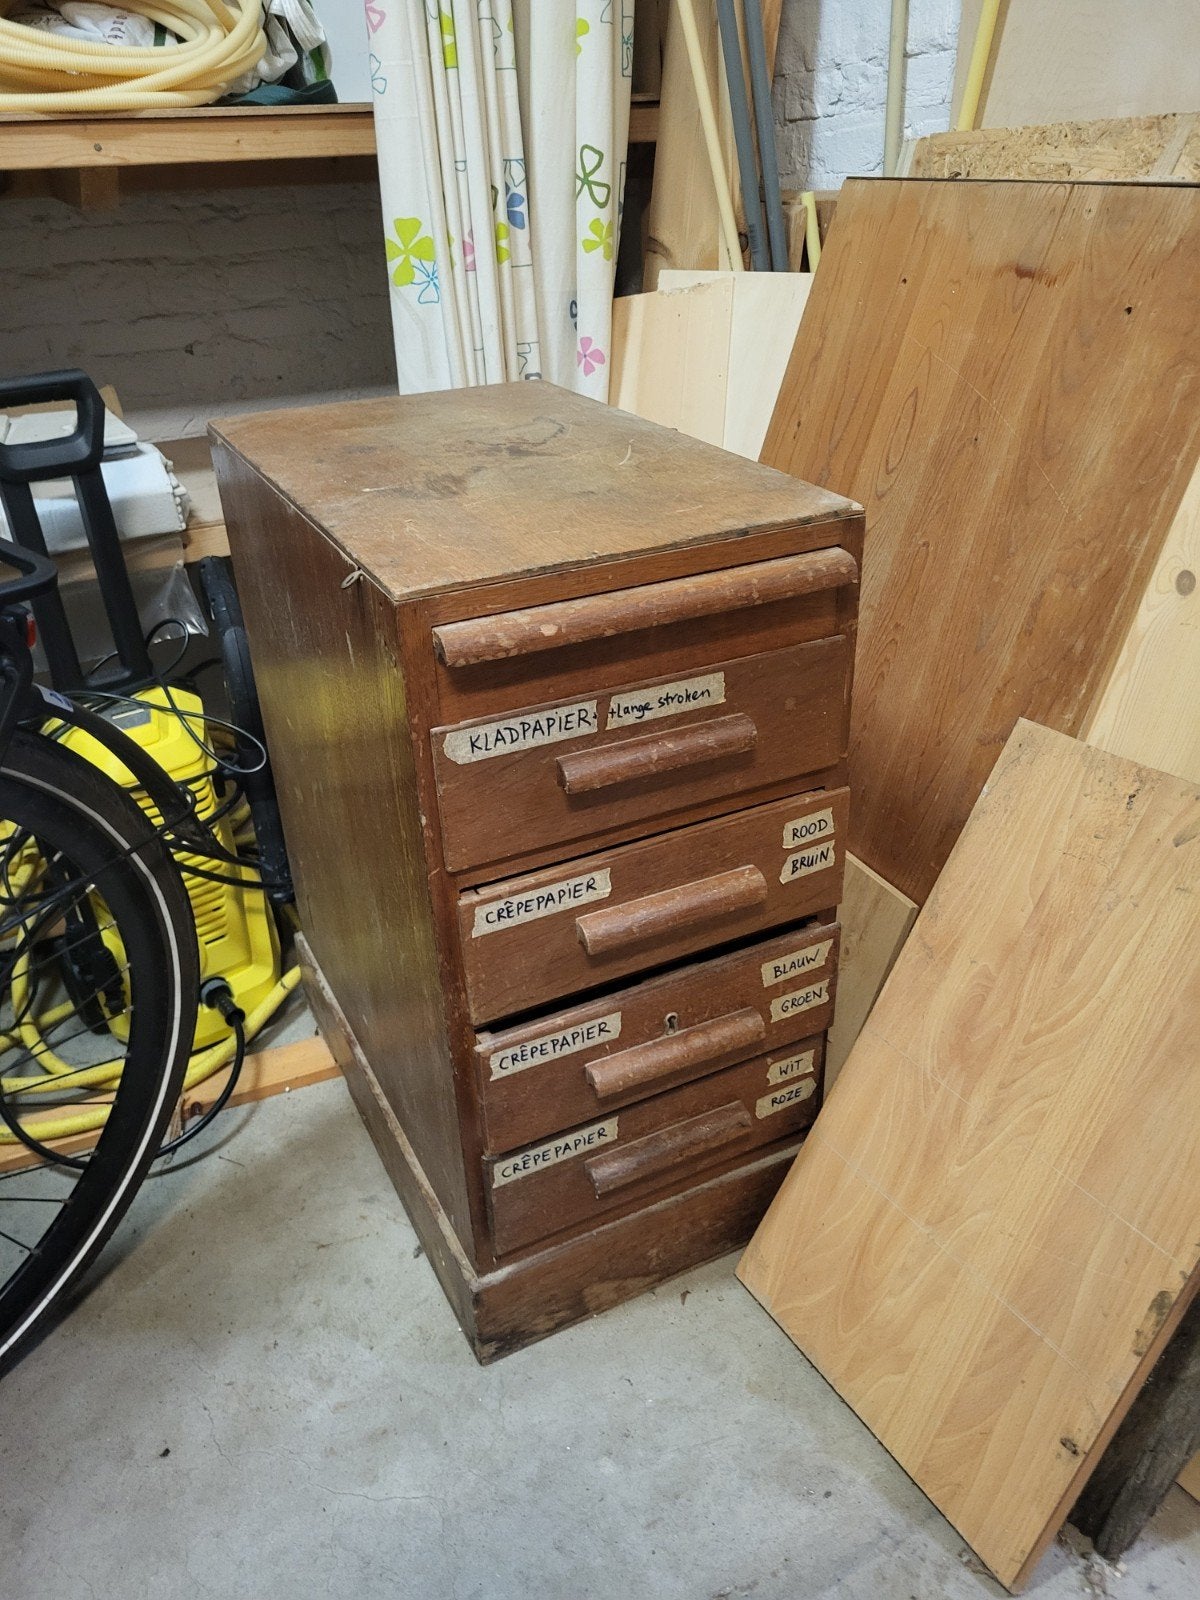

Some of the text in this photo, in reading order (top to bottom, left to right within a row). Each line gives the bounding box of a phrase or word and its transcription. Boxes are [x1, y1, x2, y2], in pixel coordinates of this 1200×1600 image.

[657, 688, 711, 708] stroken
[792, 818, 828, 841] ROOD
[773, 948, 820, 978] BLAUW
[781, 987, 822, 1013] GROEN
[771, 1086, 803, 1107] ROZE
